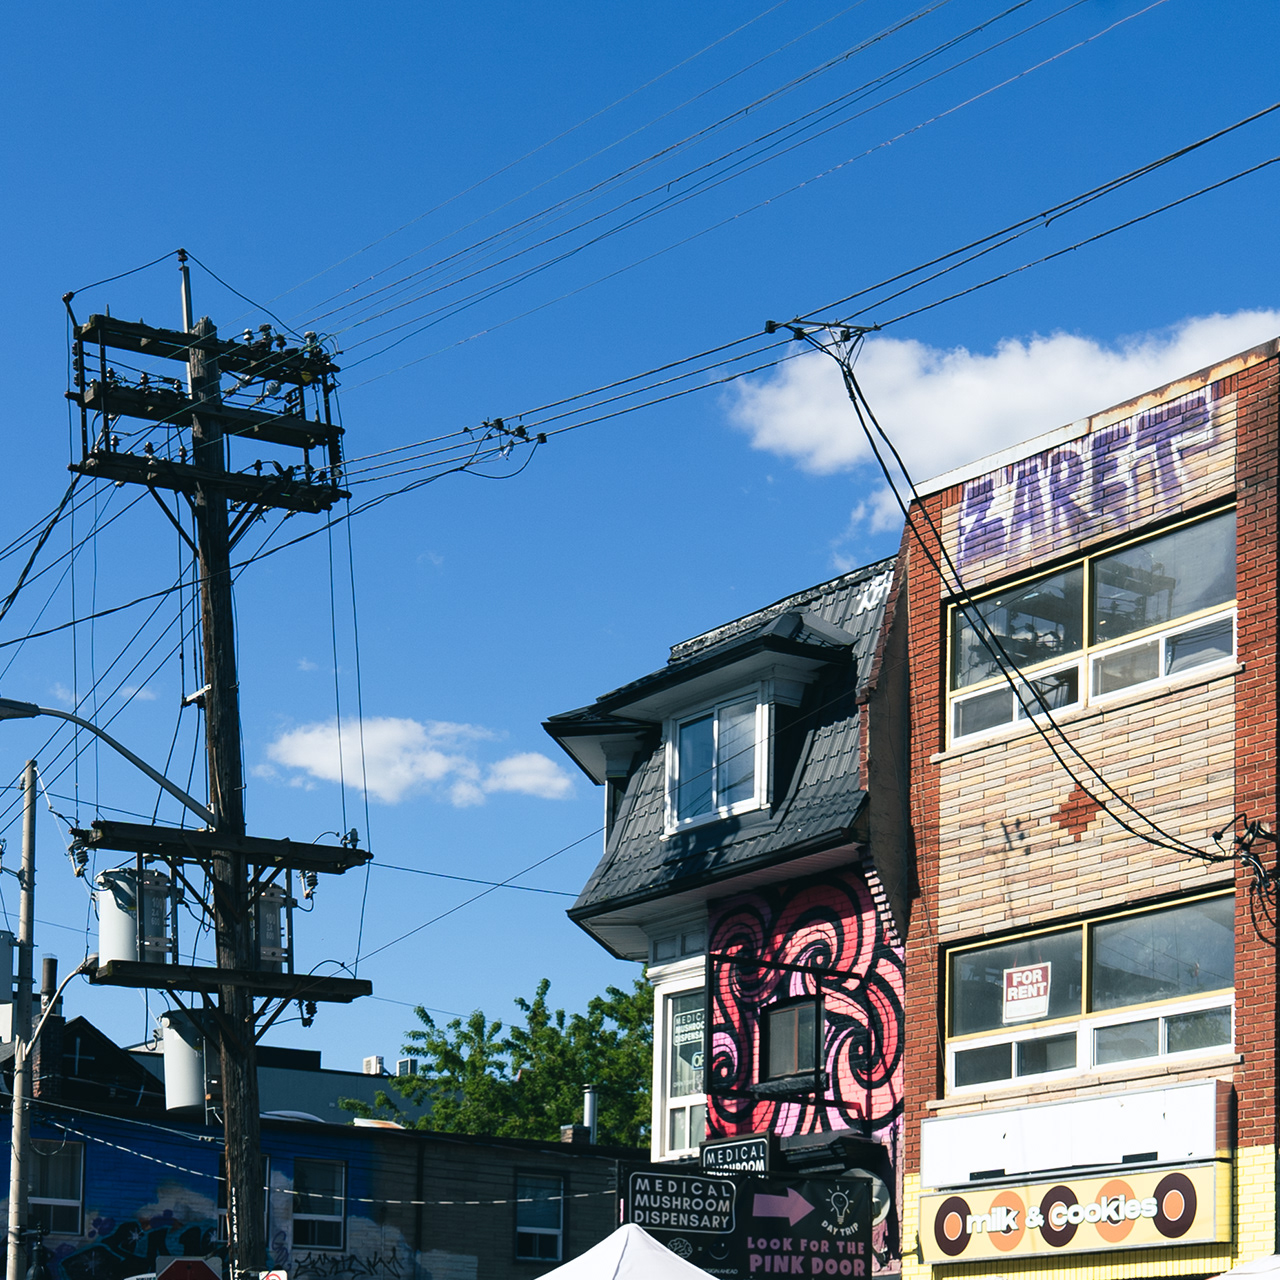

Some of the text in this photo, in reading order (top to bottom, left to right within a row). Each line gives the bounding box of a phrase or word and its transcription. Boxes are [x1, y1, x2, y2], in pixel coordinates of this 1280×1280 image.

[1012, 969, 1043, 987] FOR
[1007, 981, 1048, 1001] RENT
[705, 1144, 766, 1164] MEDICAL
[635, 1177, 731, 1198] MEDICAL
[634, 1194, 731, 1213] MUSHROOM
[634, 1210, 730, 1229] DISPENSARY
[966, 1194, 1158, 1234] milk & cookies
[820, 1220, 860, 1236] DAY TRIP
[747, 1236, 866, 1255] LOOK FOR THE
[749, 1254, 866, 1278] PINK DOOR
